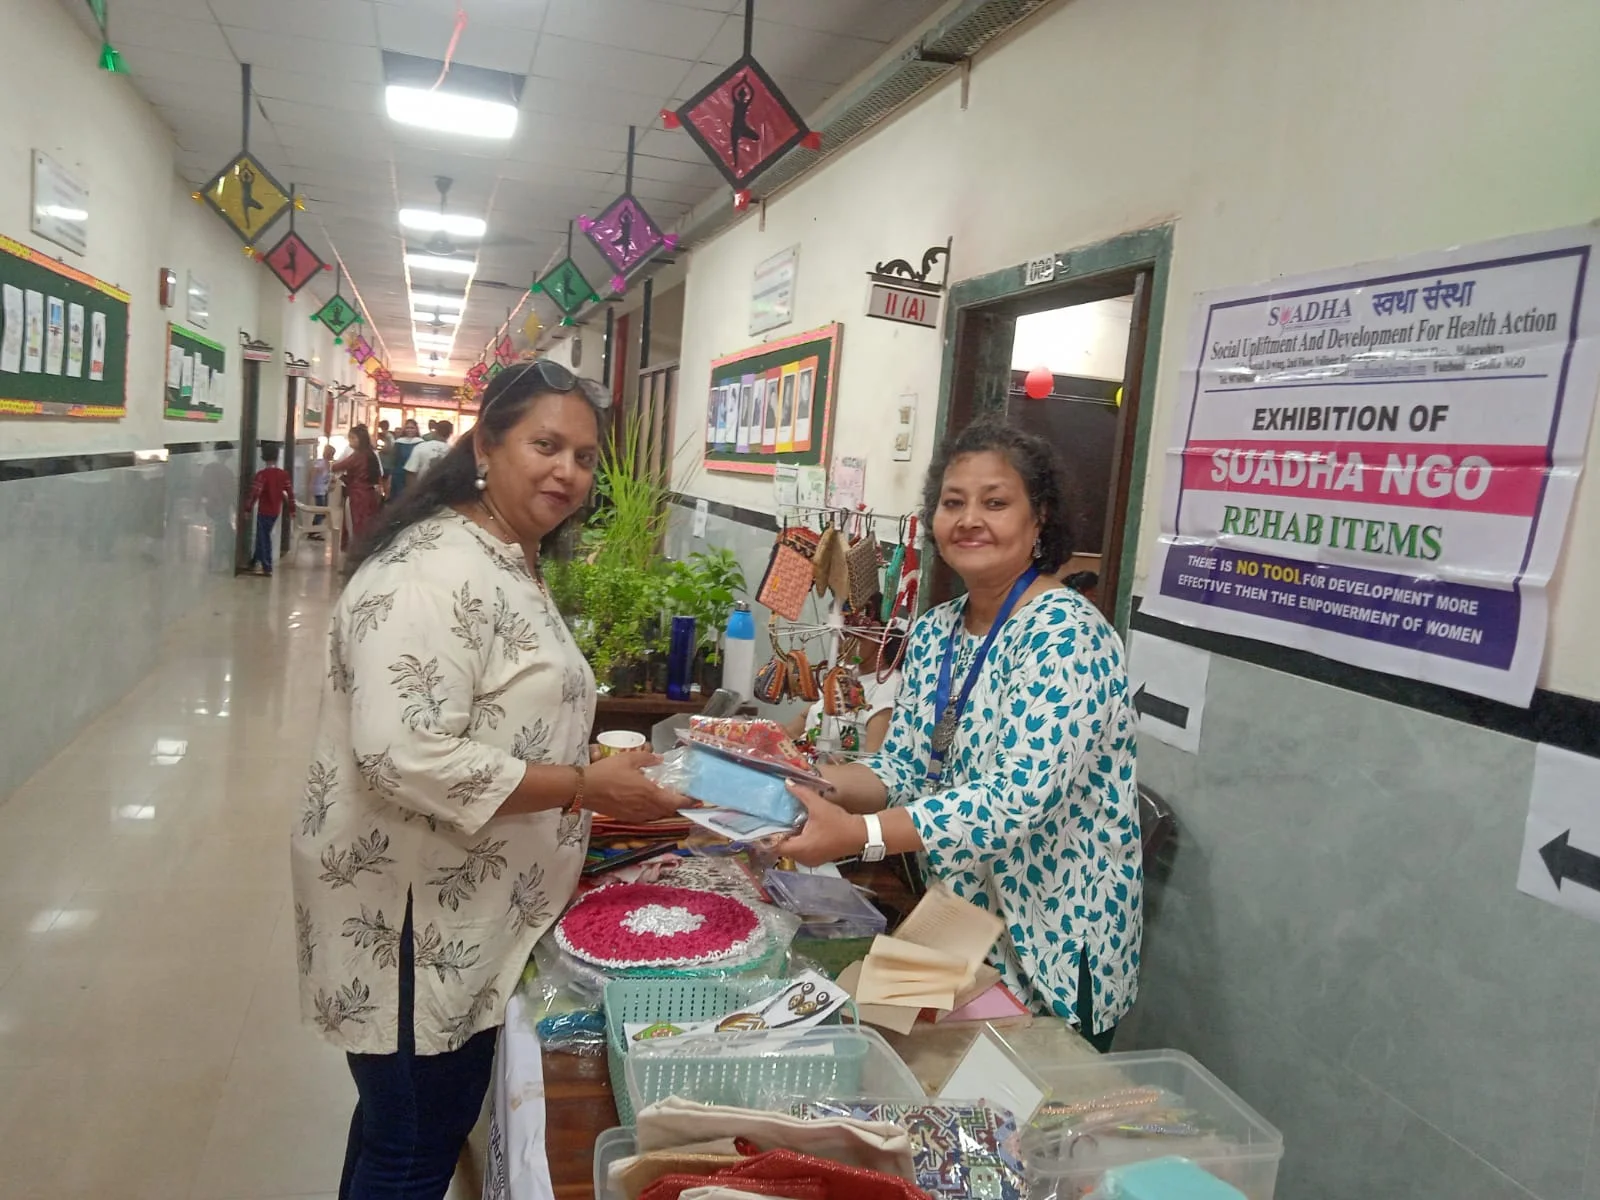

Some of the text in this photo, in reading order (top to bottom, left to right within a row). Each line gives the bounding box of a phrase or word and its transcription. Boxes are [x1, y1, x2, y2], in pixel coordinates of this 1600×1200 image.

[902, 296, 926, 322] (A)
[1372, 280, 1476, 316] स्वधा संस्था
[1211, 337, 1241, 360] Social
[1242, 335, 1298, 364] Upliftment
[1298, 330, 1326, 351] And
[1327, 325, 1415, 351] Development
[1416, 318, 1444, 342] For
[1446, 311, 1497, 339] Health
[1499, 306, 1558, 335] Action
[1252, 405, 1449, 432] EXHIBITION OF
[1211, 448, 1493, 501] SUADHA NGO
[1219, 505, 1443, 561] REHAB ITEMS
[1178, 574, 1232, 595] EFFECTIVE
[1234, 583, 1267, 601] THEN
[1270, 591, 1297, 607] THE
[1402, 616, 1423, 632] OF
[1425, 619, 1484, 645] WOMEN
[1220, 559, 1233, 572] IS
[1236, 560, 1259, 576] NO
[1262, 563, 1301, 585] TOOL
[1303, 573, 1325, 589] FOR
[1328, 578, 1434, 608] DEVELOPMENT
[1436, 595, 1479, 616] MORE
